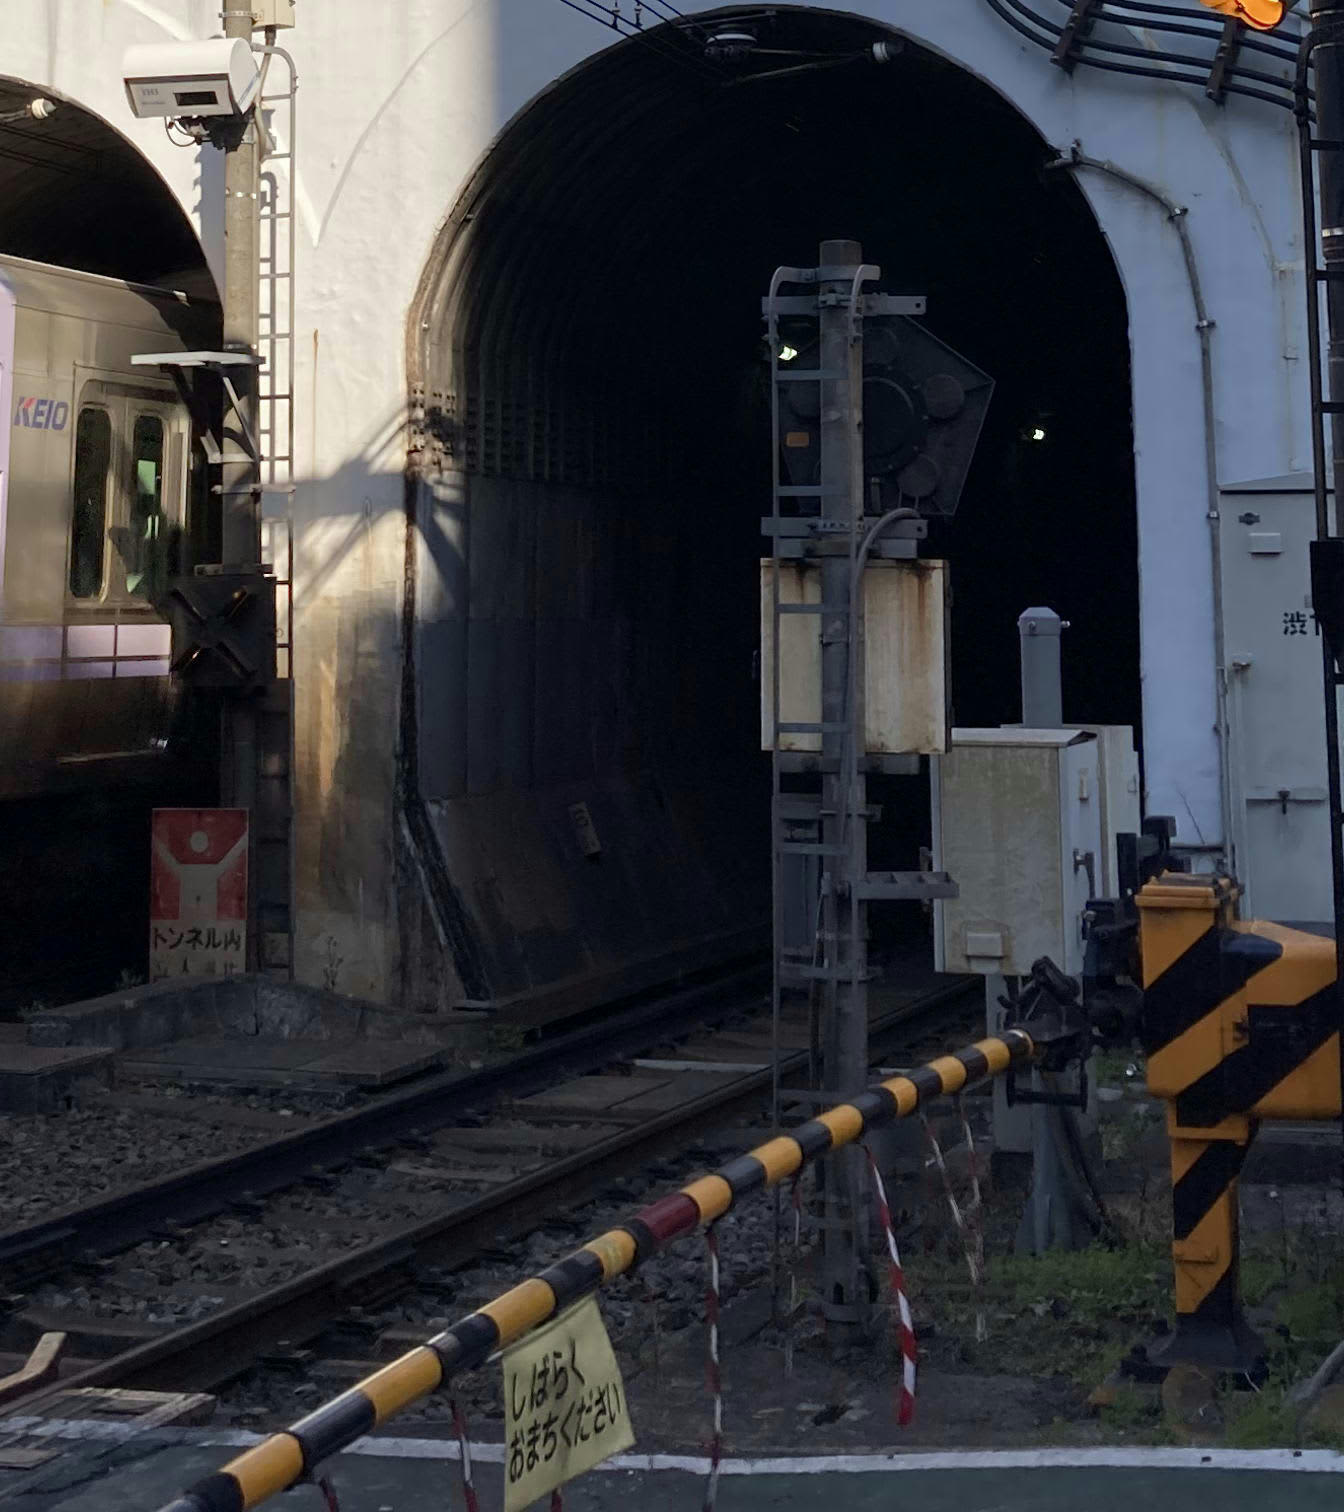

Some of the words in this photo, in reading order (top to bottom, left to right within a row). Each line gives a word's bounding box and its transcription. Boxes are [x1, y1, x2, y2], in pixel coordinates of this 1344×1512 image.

[14, 396, 69, 431] KEIO
[153, 927, 241, 951] トンネル内
[511, 1335, 586, 1422] しばらく
[508, 1383, 622, 1484] おまちください
